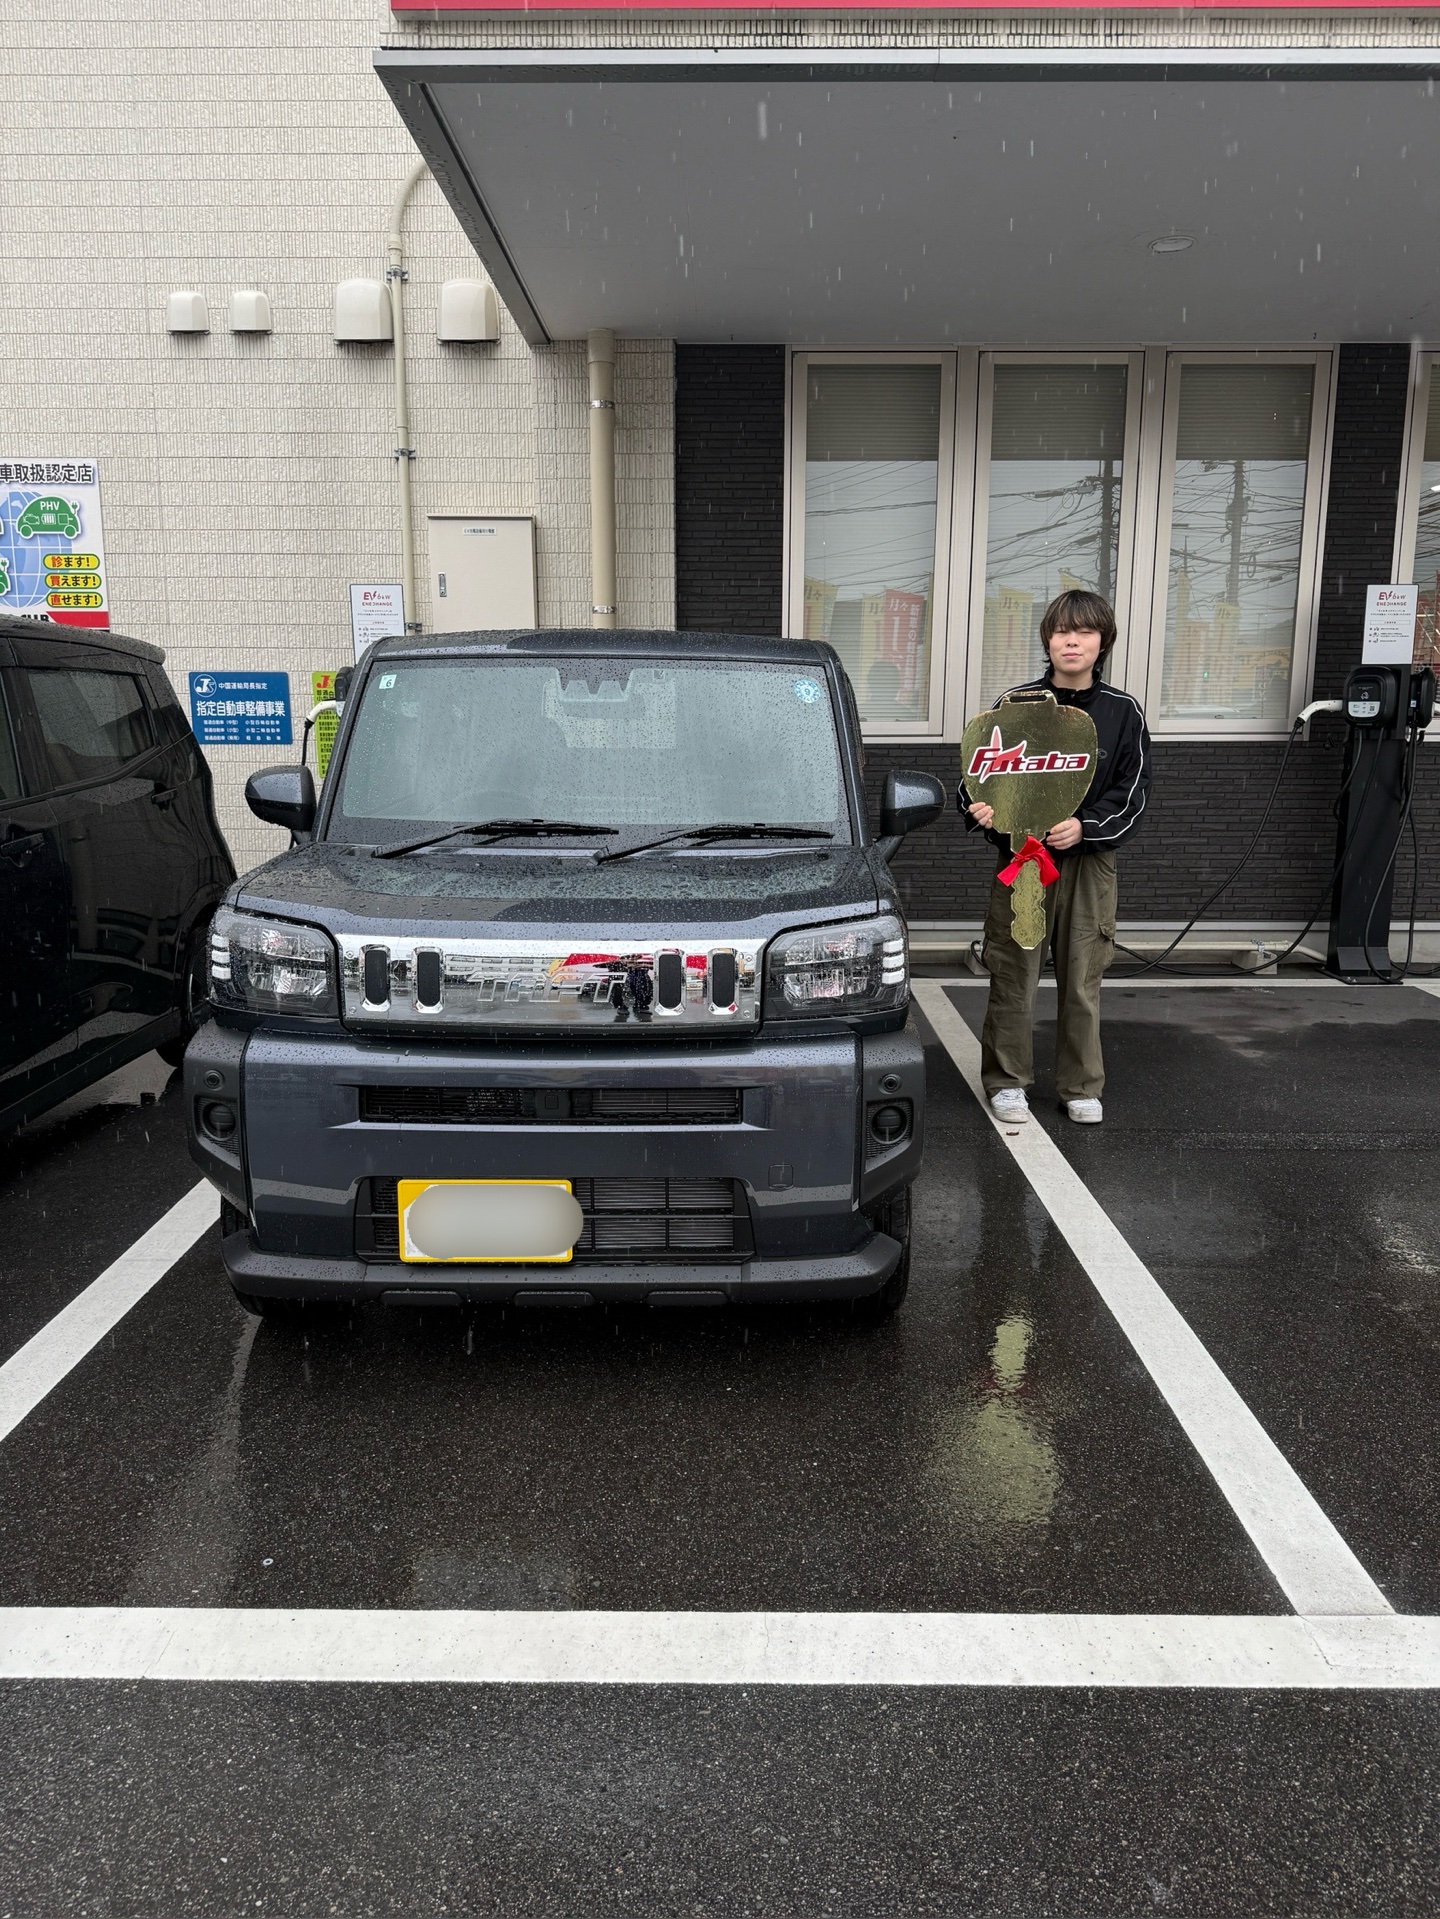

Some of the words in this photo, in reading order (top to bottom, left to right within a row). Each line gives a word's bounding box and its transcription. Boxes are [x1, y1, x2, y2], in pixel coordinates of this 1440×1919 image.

[0, 464, 92, 482] 車取扱認定店
[40, 501, 60, 511] PHV
[51, 556, 90, 567] 診ます!
[50, 575, 96, 586] 買えます!
[51, 594, 98, 606] 直せます!
[386, 679, 392, 687] 6
[196, 701, 286, 717] 指定自動車整備事業
[968, 740, 1090, 777] Futaba
[467, 972, 628, 1002] TAFT
